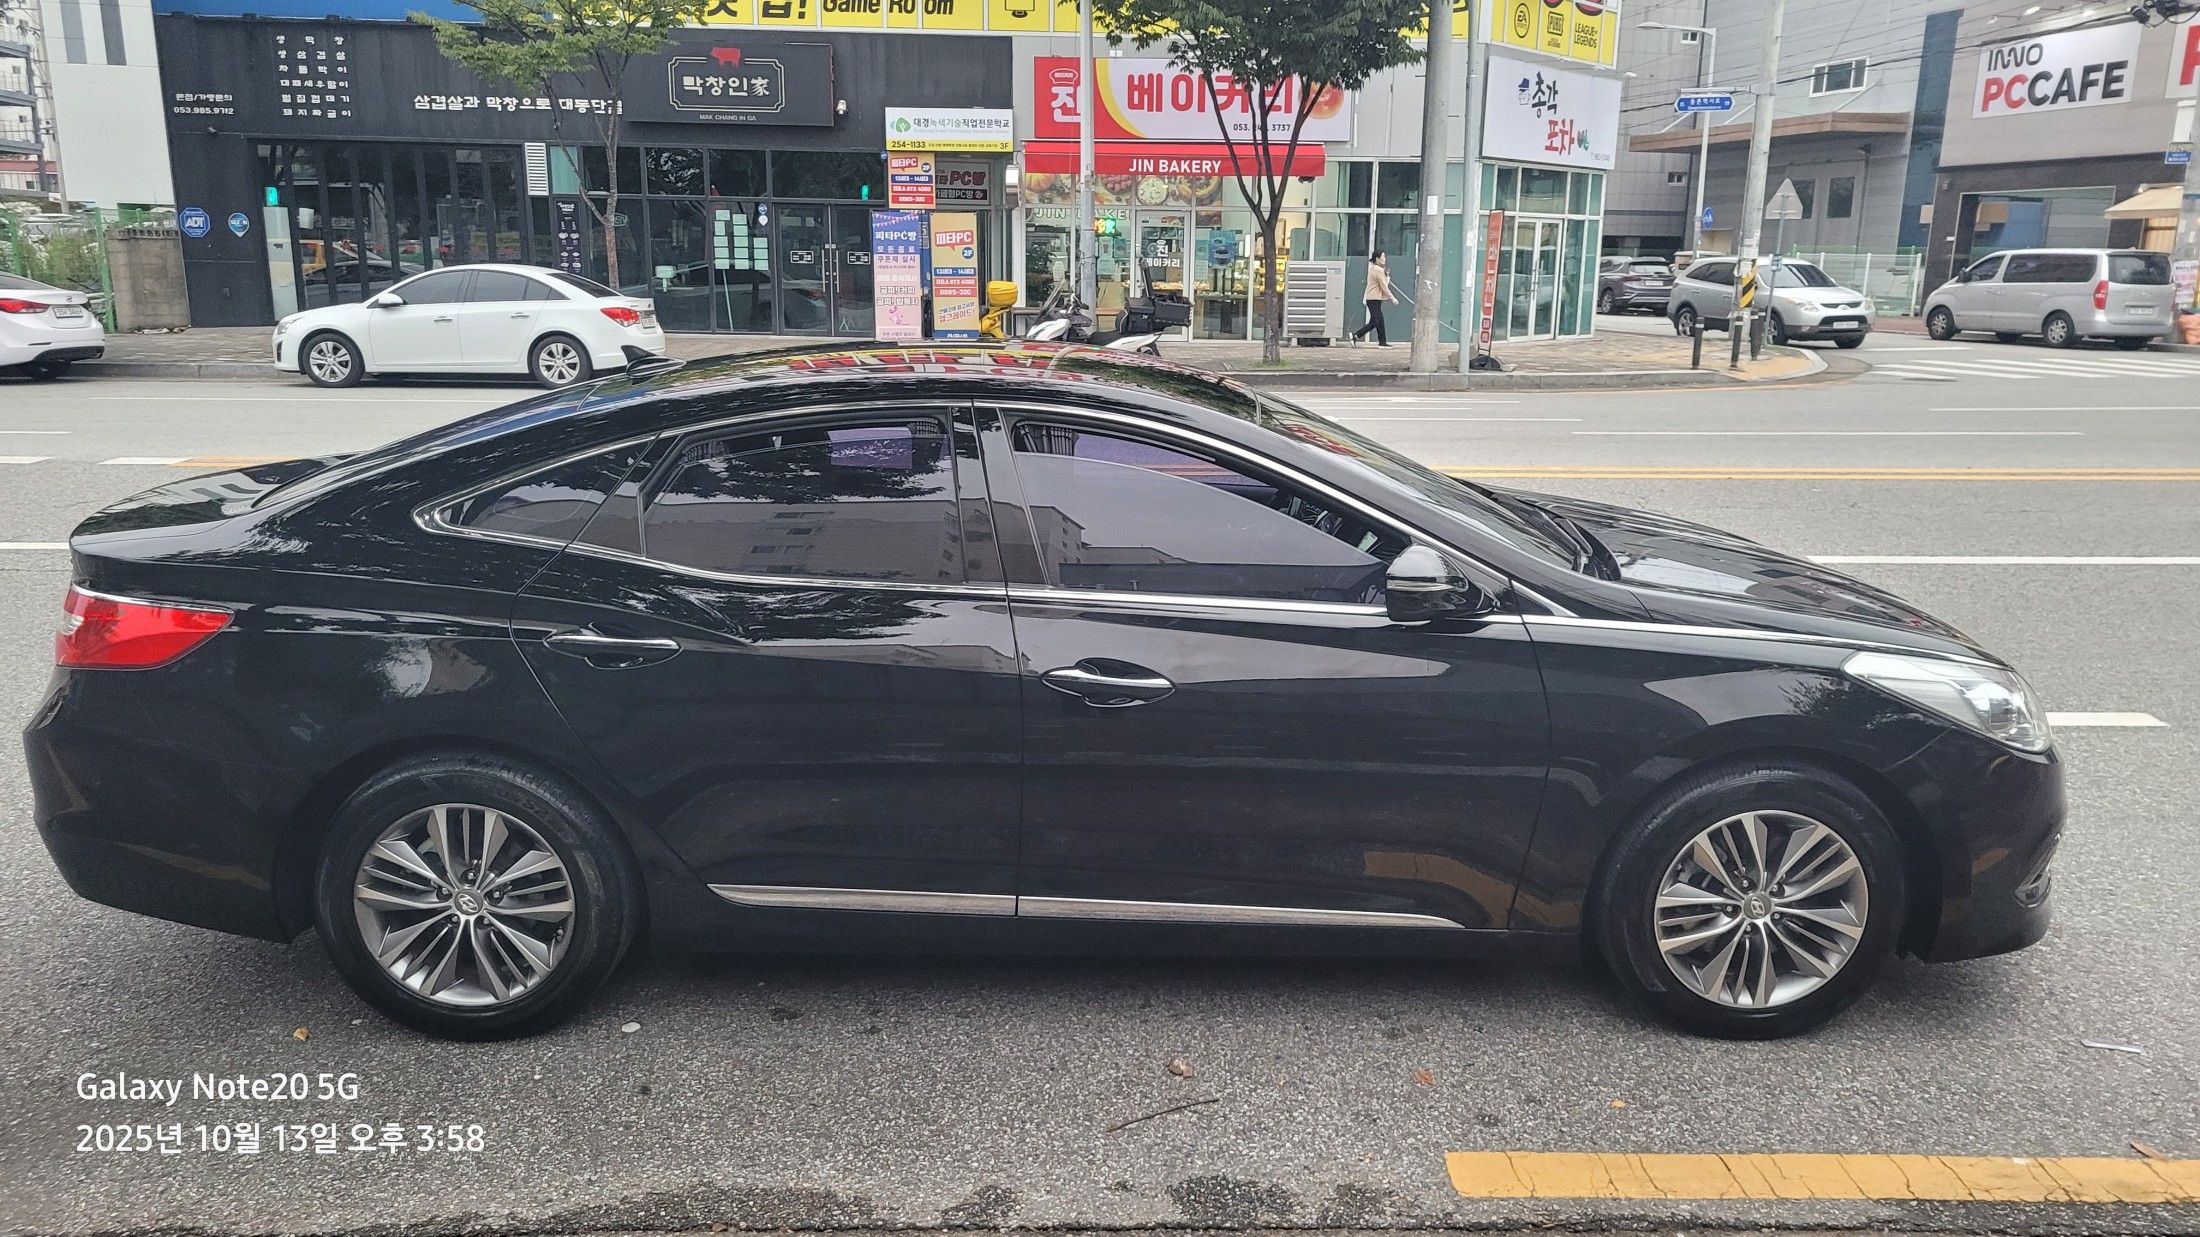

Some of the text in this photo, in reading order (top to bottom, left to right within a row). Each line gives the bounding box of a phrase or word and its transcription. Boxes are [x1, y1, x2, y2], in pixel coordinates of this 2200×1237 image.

[1574, 22, 1595, 36] LEAGUE
[1573, 34, 1597, 48] LEGENDS
[1987, 43, 2043, 72] INNO
[683, 76, 770, 97] 막창인家
[414, 95, 480, 111] 삼겹살과
[486, 96, 552, 112] 막창으로
[913, 117, 1010, 128] 대경녹색기술직업전문학교
[1271, 124, 1290, 132] 3737
[1545, 119, 1575, 156] 포차
[1129, 160, 1221, 173] JIN BAKERY
[1035, 208, 1065, 219] JIN
[186, 217, 204, 227] ADT
